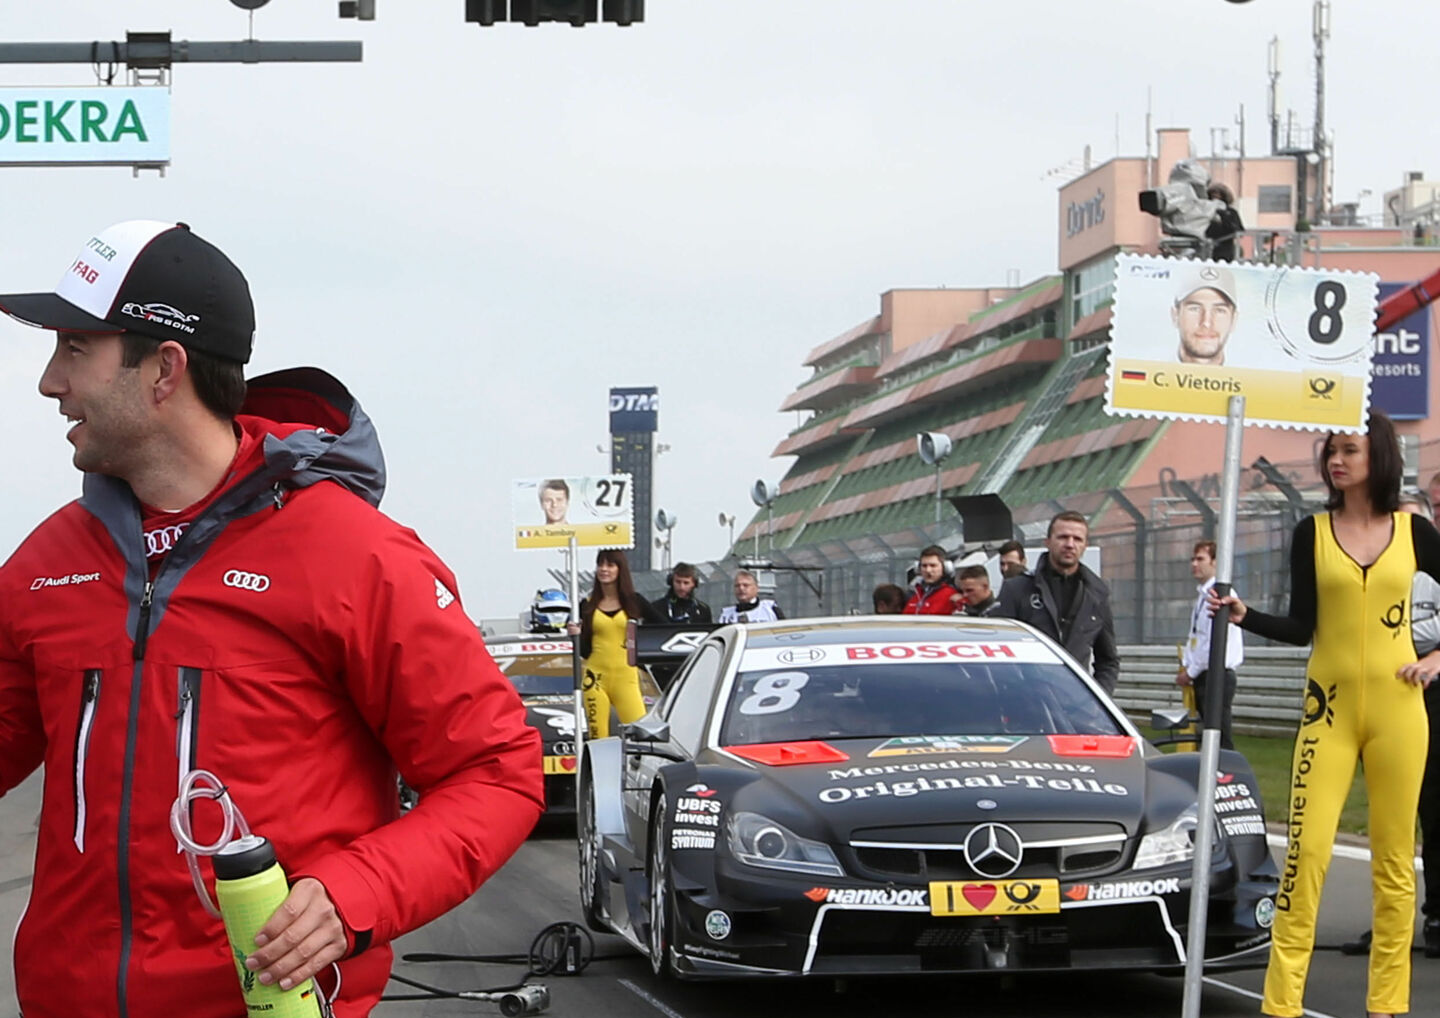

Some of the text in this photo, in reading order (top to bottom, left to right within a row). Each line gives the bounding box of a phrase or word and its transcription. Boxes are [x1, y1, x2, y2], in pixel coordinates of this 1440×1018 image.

[73, 259, 100, 285] FAG
[1308, 279, 1347, 345] 8
[172, 320, 196, 335] DTM
[1373, 328, 1421, 355] nt
[1153, 372, 1242, 393] C. Vietoris
[610, 393, 658, 412] DTM
[595, 479, 627, 508] 27
[533, 529, 543, 538] A.
[44, 571, 101, 587] Audi Sport
[521, 643, 574, 652] BOS
[846, 644, 1016, 661] BOSCH
[739, 671, 809, 715] 8
[827, 759, 1095, 781] Mercedes-Benz
[818, 774, 1128, 803] Original-Teile
[677, 798, 722, 813] UBFS
[674, 810, 720, 827] invest
[1276, 735, 1320, 913] Deutsche Post
[672, 828, 716, 837] PETRONAS
[671, 835, 716, 850] SYNTIUM
